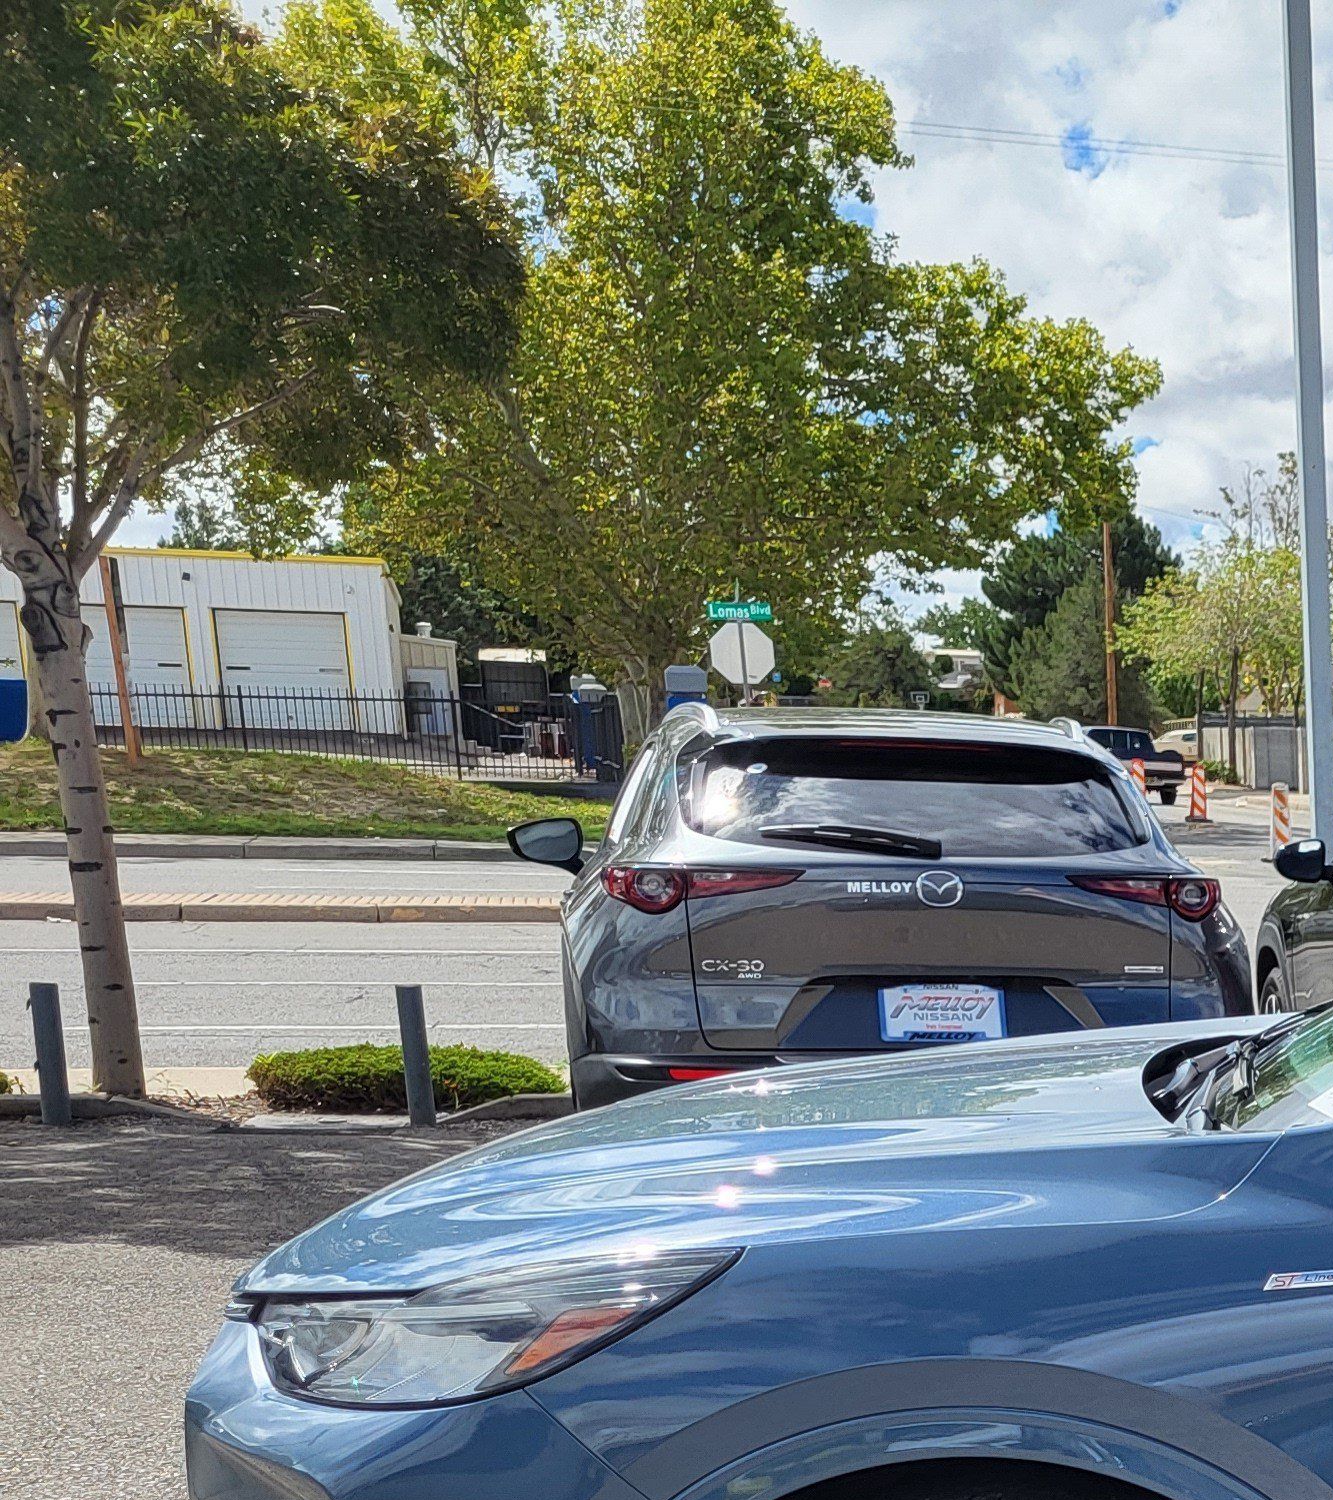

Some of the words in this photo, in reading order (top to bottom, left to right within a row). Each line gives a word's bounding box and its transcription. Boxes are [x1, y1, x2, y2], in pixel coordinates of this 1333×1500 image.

[709, 603, 750, 618] Lomas
[750, 603, 771, 615] Blvd
[847, 882, 912, 893] MELLOY
[701, 960, 765, 971] CX-30
[890, 996, 995, 1019] MELLOY
[913, 1012, 974, 1021] NISSAN
[909, 1032, 977, 1040] MELLOY
[1273, 1275, 1300, 1287] ST
[1304, 1274, 1333, 1282] Line
